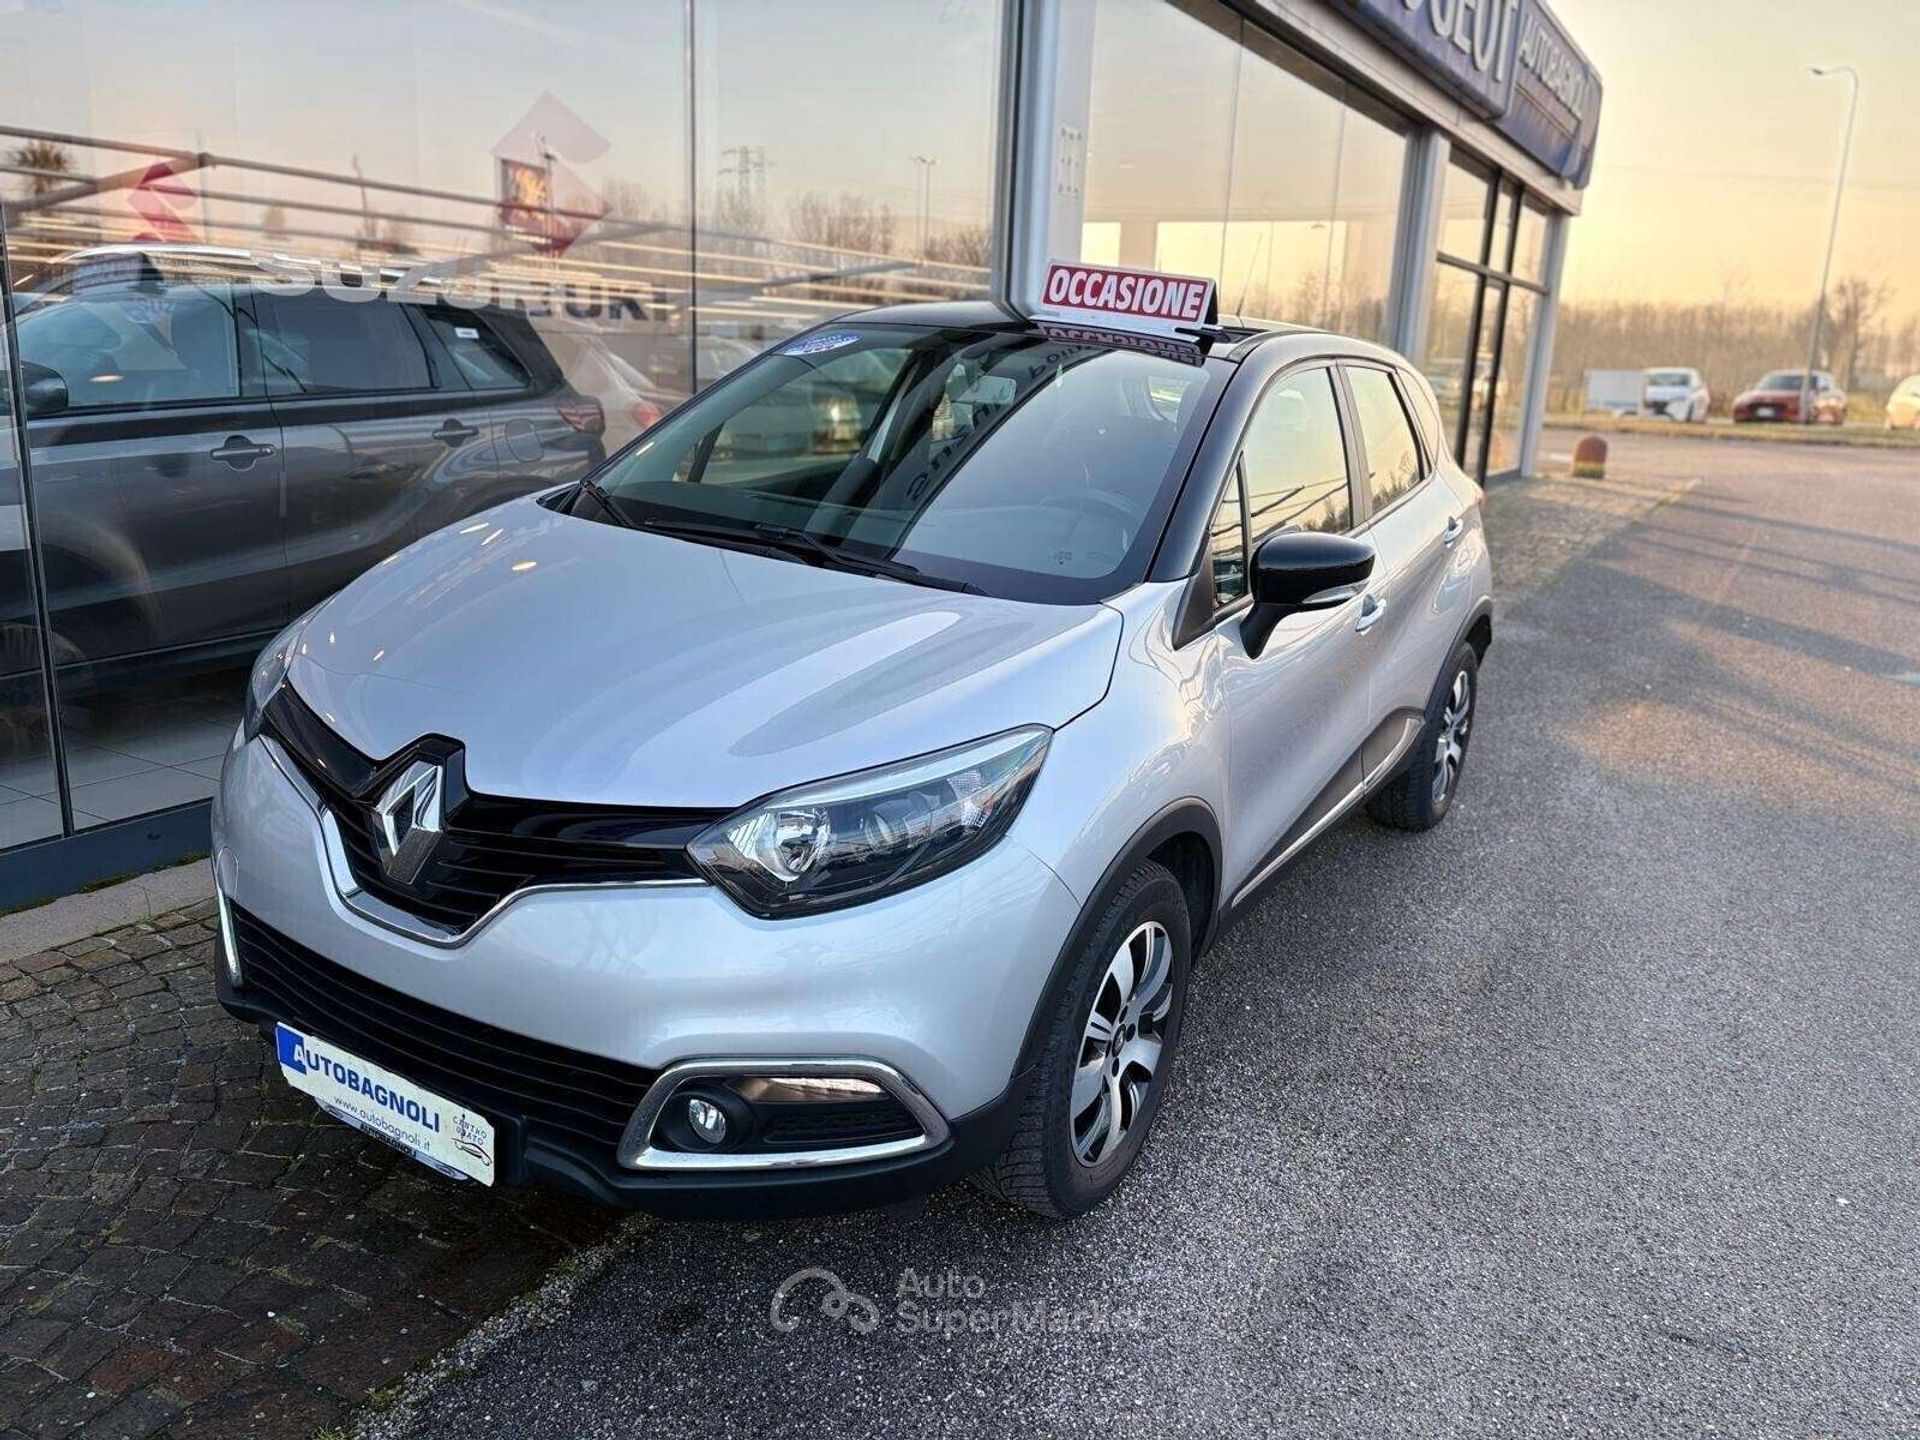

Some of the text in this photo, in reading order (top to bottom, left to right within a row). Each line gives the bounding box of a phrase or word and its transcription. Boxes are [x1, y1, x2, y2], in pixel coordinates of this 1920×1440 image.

[1049, 268, 1204, 318] OCCASIONE
[293, 1043, 440, 1133] AUTOBAGNOLI
[334, 1096, 430, 1152] www.autobagnoli.it
